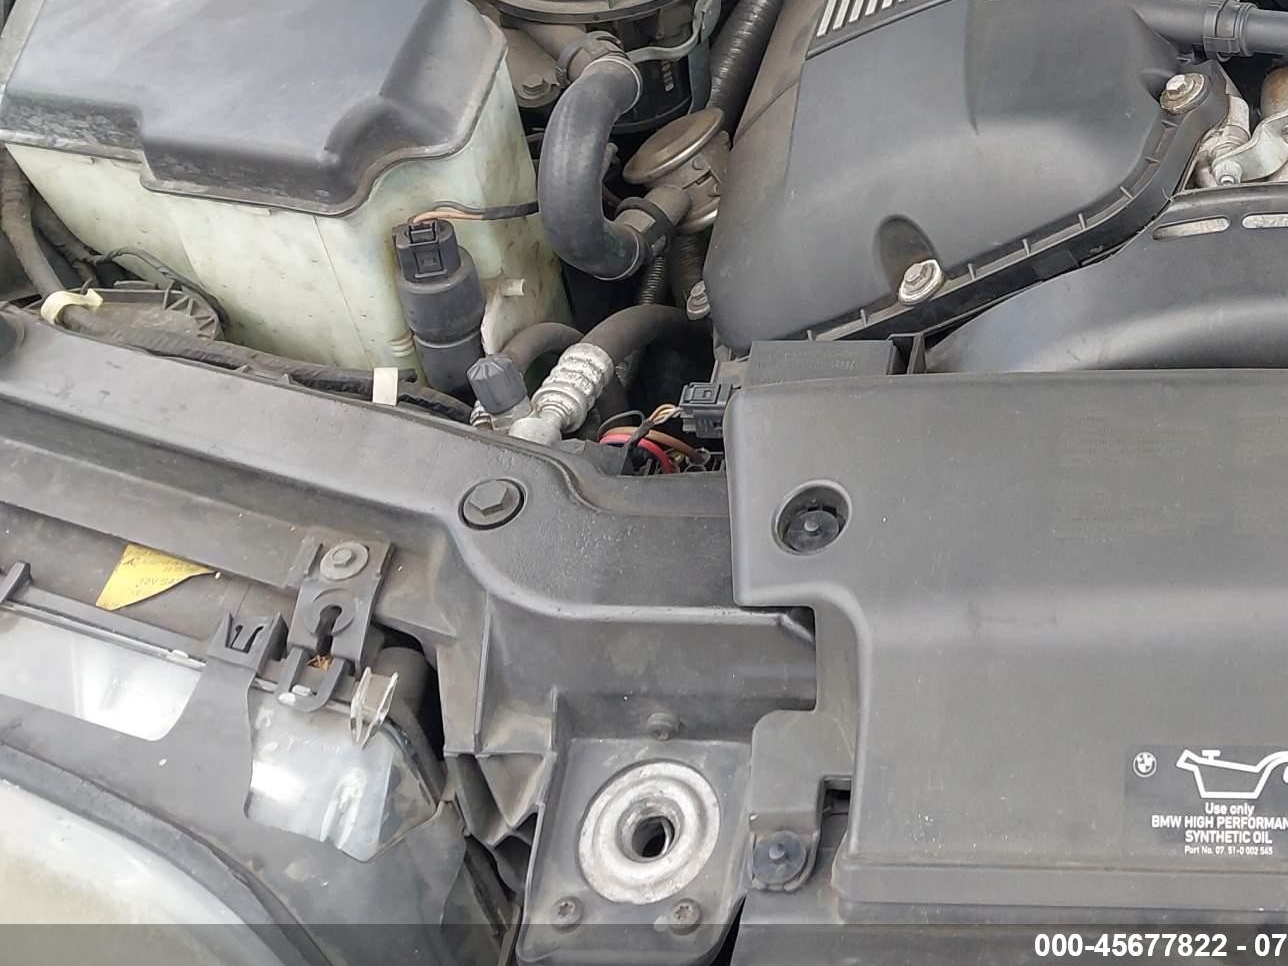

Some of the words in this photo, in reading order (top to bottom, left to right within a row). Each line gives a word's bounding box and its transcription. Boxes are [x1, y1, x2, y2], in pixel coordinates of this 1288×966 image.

[1205, 802, 1227, 815] Use
[1229, 802, 1255, 818] only
[1151, 815, 1182, 828] BMW
[1184, 815, 1214, 828] HIGH
[1185, 830, 1250, 843] SYNTHETIC
[1253, 831, 1273, 844] OIL
[1184, 845, 1199, 854] Part
[1201, 845, 1213, 854] No.
[1215, 846, 1224, 854] 07
[1245, 846, 1258, 855] 002
